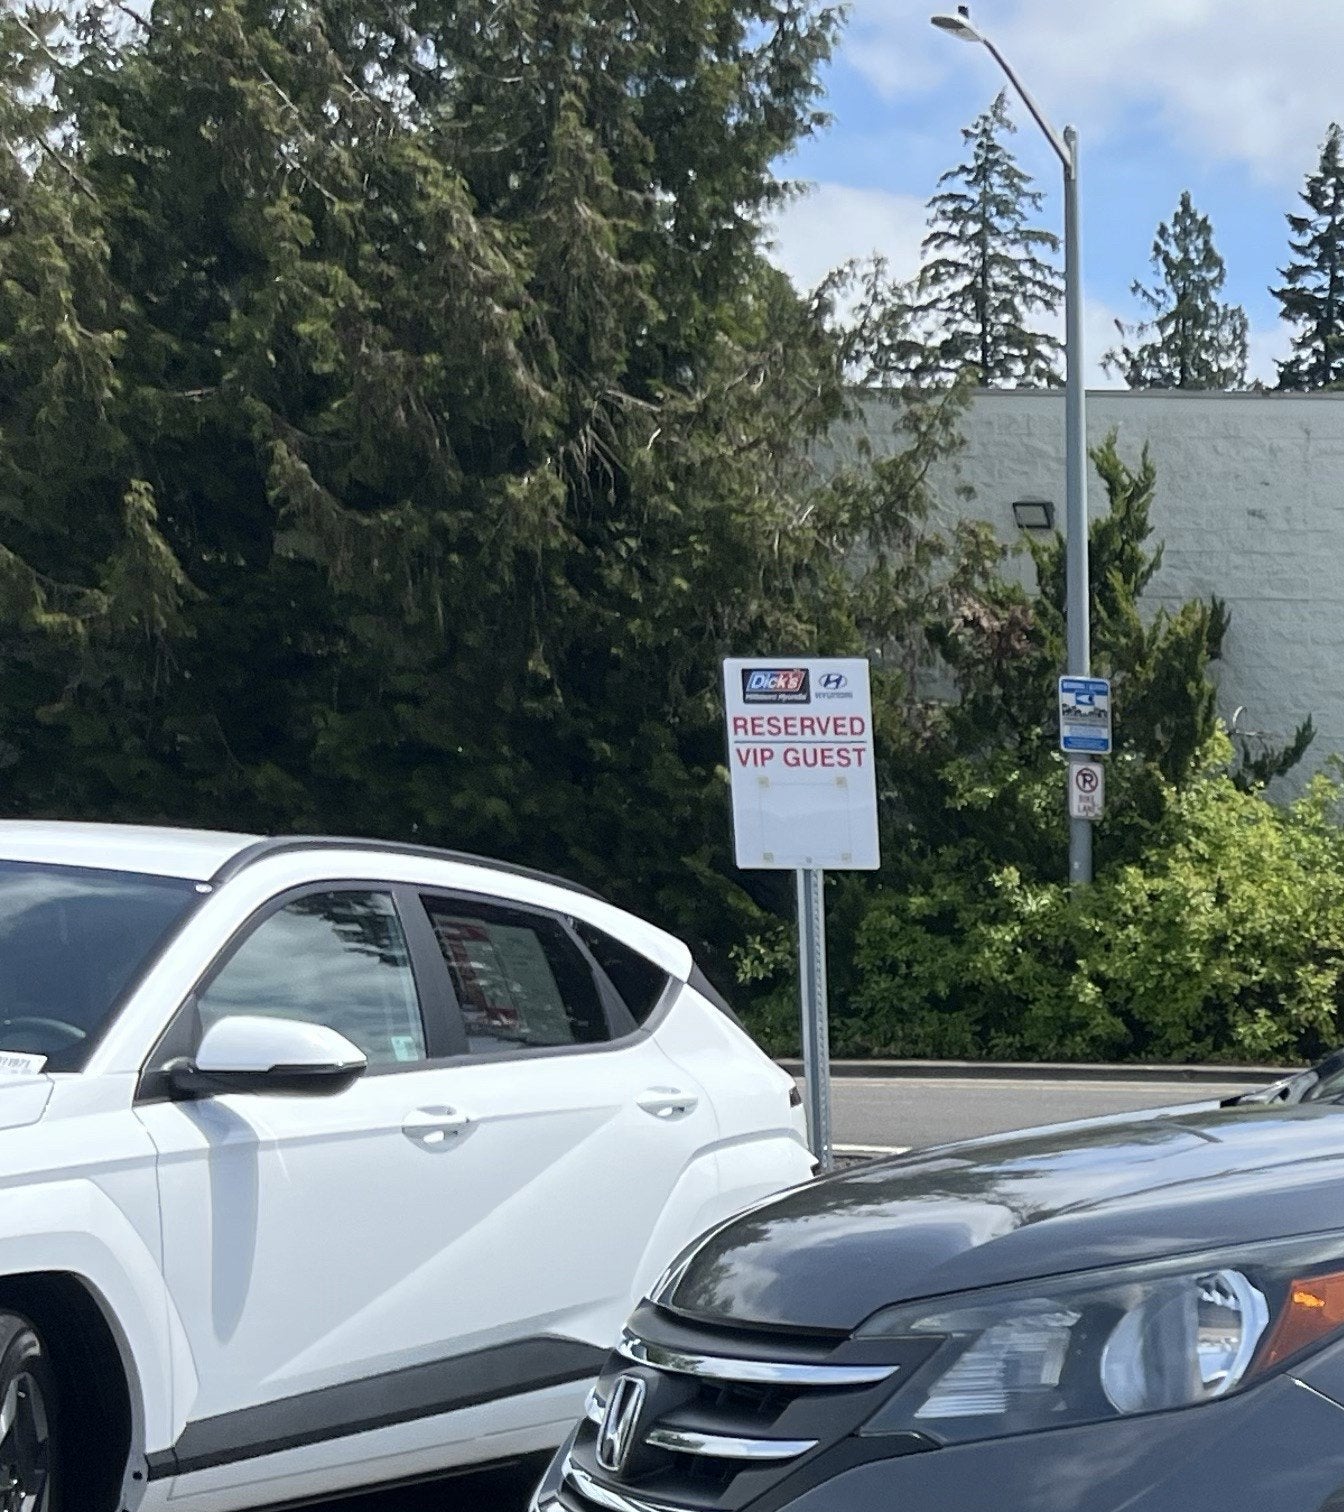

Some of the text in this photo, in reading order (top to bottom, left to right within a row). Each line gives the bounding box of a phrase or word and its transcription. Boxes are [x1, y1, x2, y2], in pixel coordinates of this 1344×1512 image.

[733, 716, 866, 736] RESERVED
[736, 747, 866, 768] VIP GUEST
